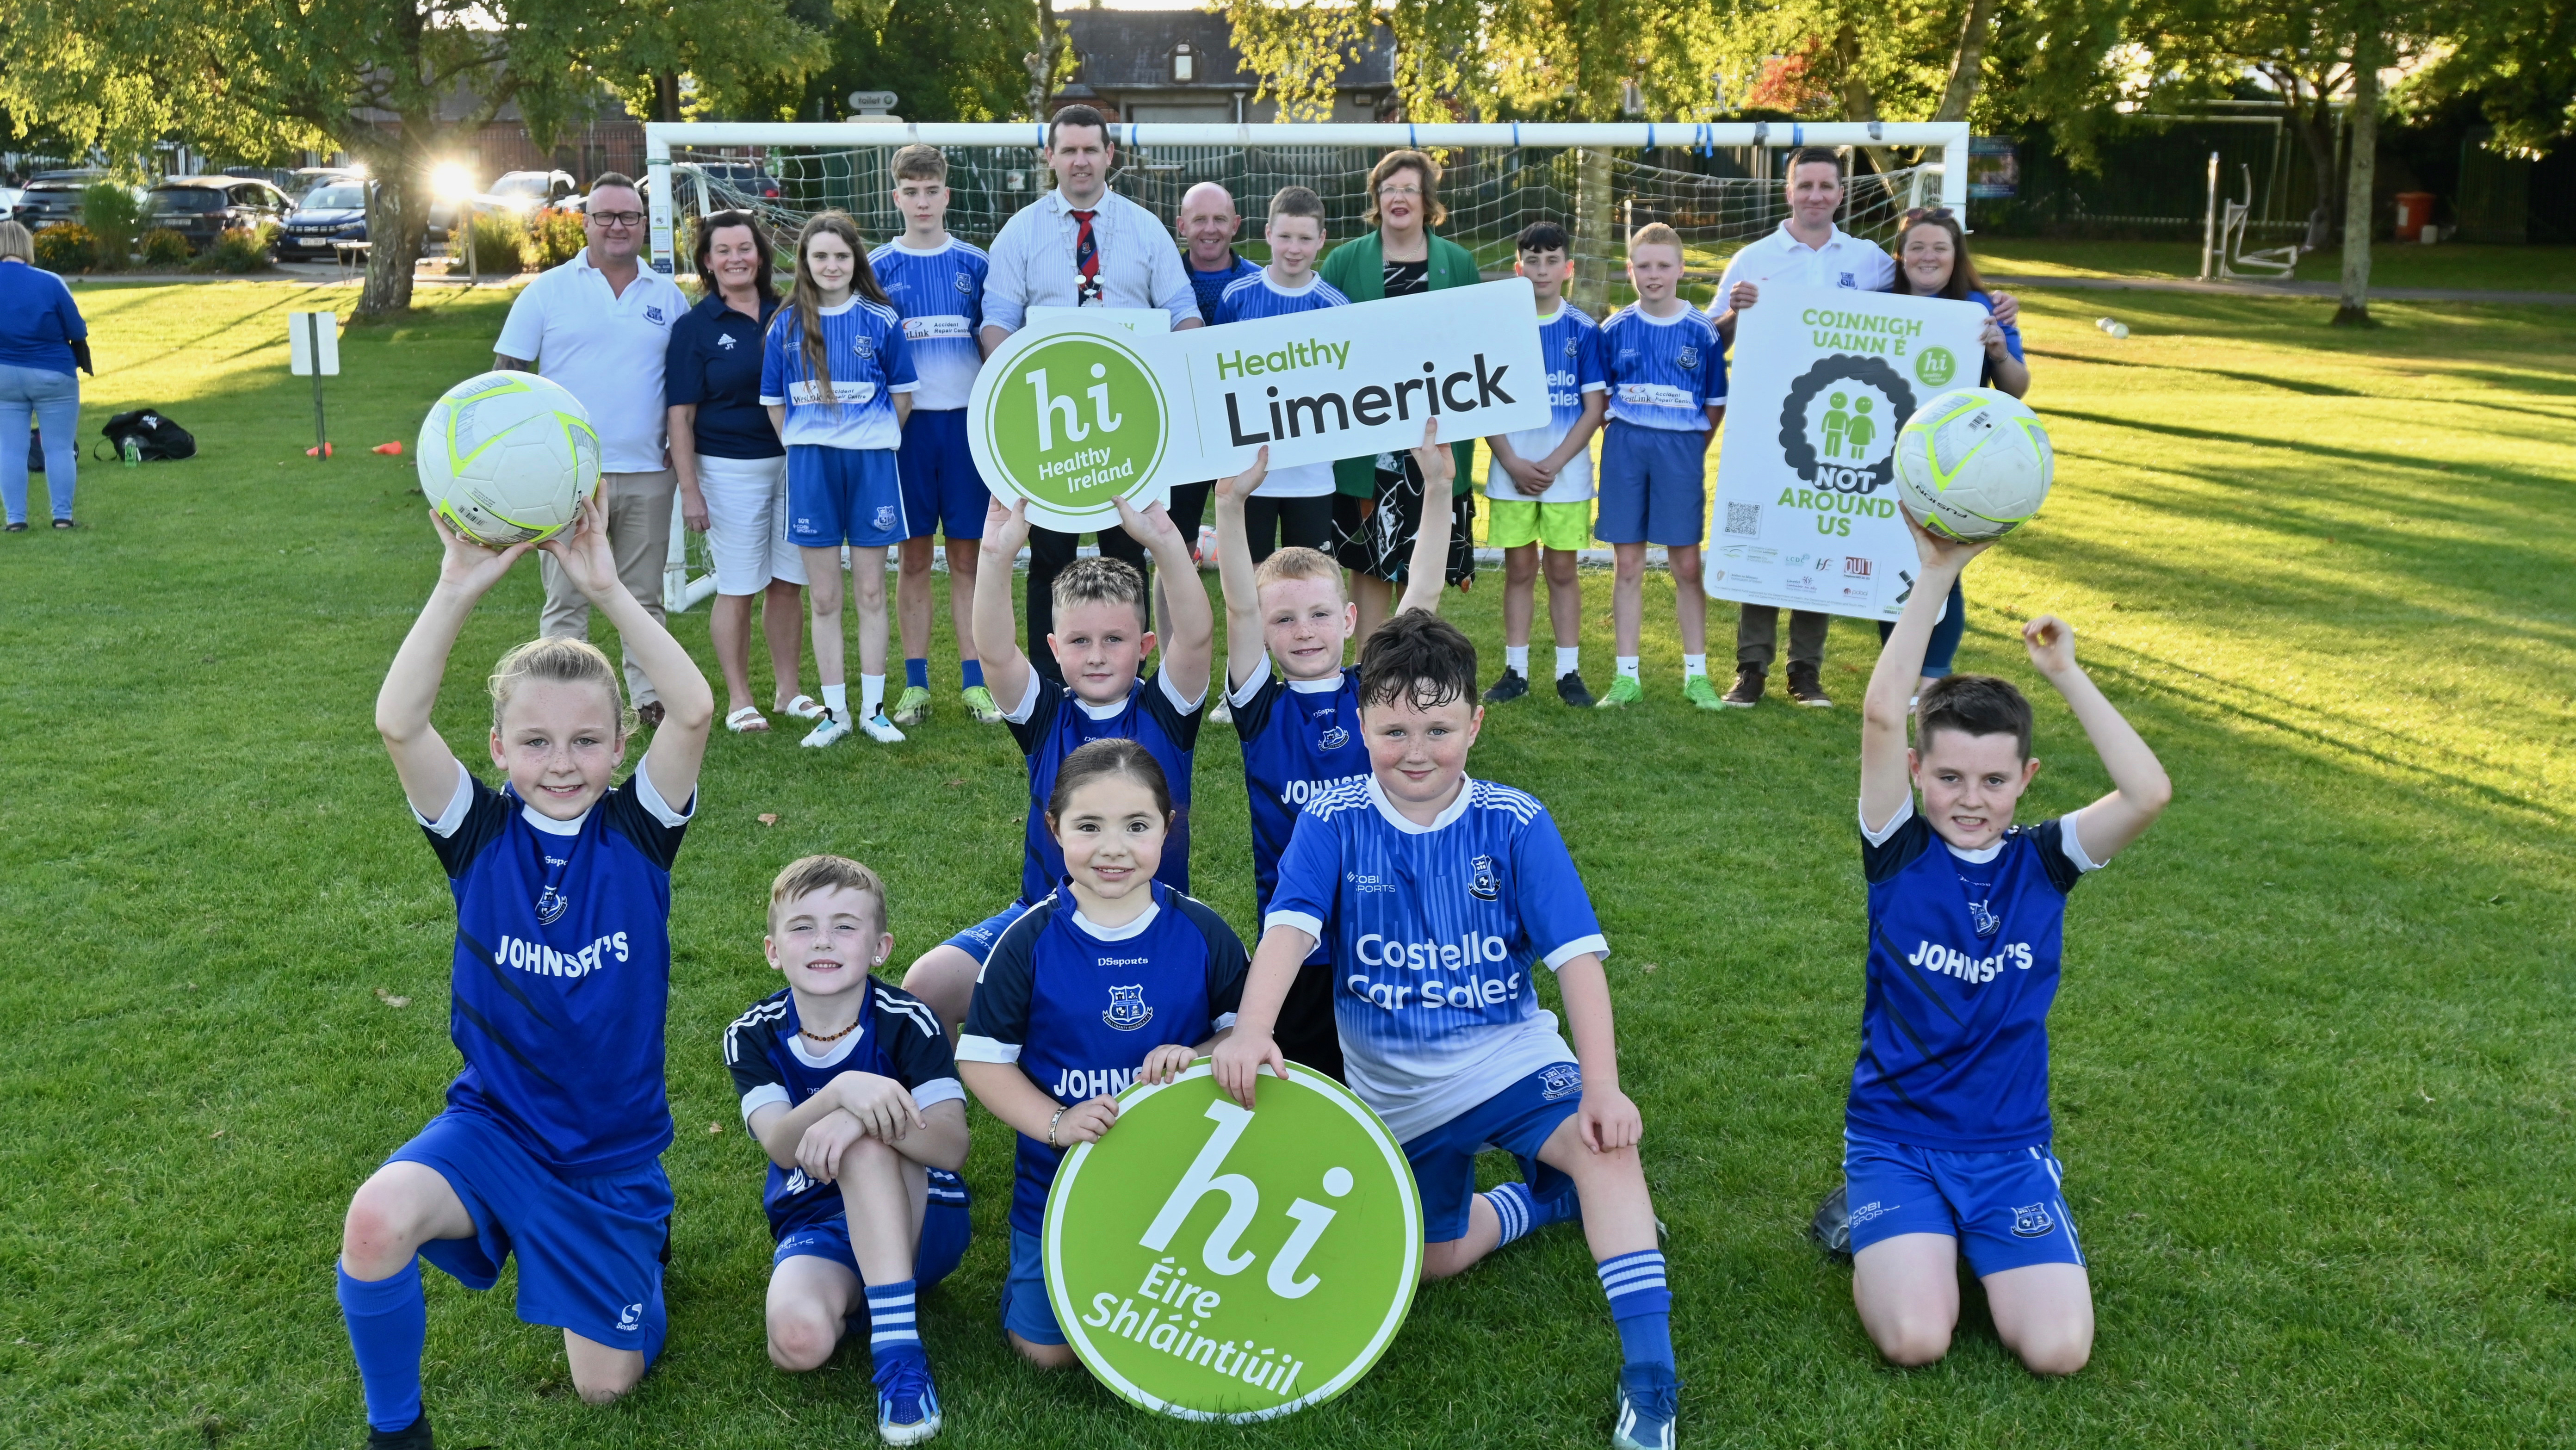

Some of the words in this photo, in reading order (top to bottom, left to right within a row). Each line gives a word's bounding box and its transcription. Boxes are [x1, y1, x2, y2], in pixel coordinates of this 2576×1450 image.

[906, 329, 929, 338] tLink
[1803, 309, 1923, 336] COINNIGH
[1814, 331, 1887, 353] UAINN
[1895, 335, 1906, 356] É
[1217, 339, 1350, 380] Healthy
[1925, 352, 1947, 371] hi
[1547, 370, 1575, 386] ello
[1026, 363, 1122, 452] hi
[1225, 354, 1515, 447] Limerick
[1549, 390, 1579, 406] ales
[1039, 446, 1111, 481] Healthy
[1068, 458, 1133, 493] Ireland
[1814, 466, 1876, 492] NOT
[1778, 488, 1895, 518] AROUND
[1916, 484, 1968, 518] FUSION
[1817, 514, 1852, 537] US
[1845, 558, 1872, 574] QUIT
[1356, 885, 1395, 893] PORTS
[966, 930, 988, 941] COBI
[978, 927, 993, 936] TM
[1098, 957, 1148, 967] DSsports
[1356, 930, 1507, 971] Costello
[1348, 974, 1414, 1010] Car
[1422, 972, 1520, 1009] Sales
[1105, 1017, 1128, 1030] BALLYNANTY
[1139, 1099, 1354, 1299] hi
[1853, 1201, 1880, 1219] COBI
[1138, 1257, 1221, 1318] Éire
[1082, 1292, 1304, 1396] Shláintiúil
